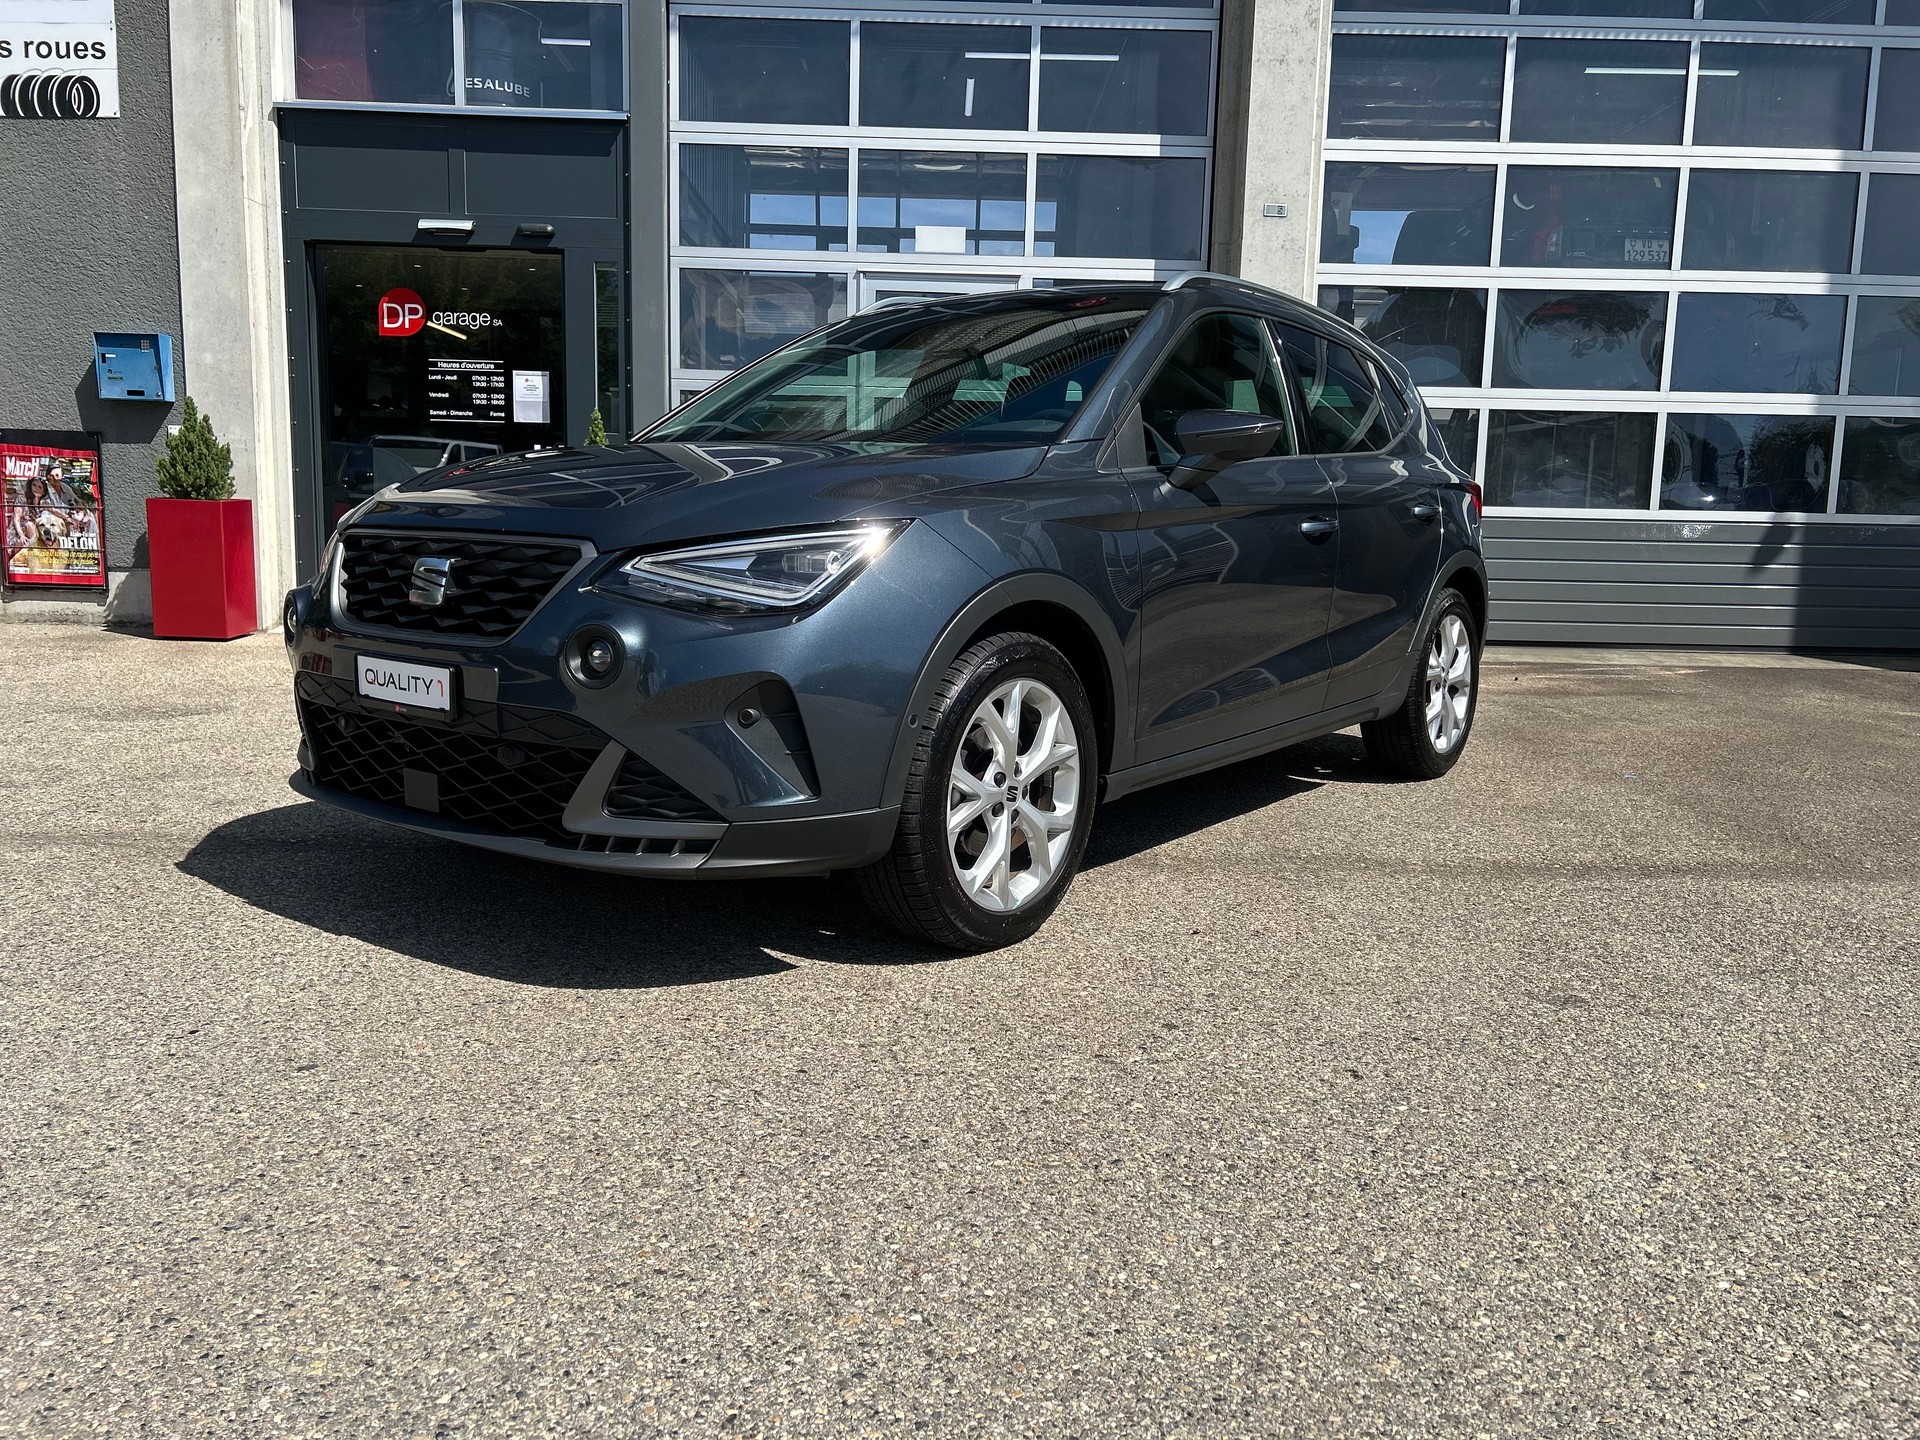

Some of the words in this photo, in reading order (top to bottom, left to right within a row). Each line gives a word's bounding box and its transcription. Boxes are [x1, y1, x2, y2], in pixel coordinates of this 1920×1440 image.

[24, 40, 107, 60] roues
[1641, 240, 1653, 249] VD
[383, 302, 424, 329] DP
[432, 311, 491, 330] garage
[492, 319, 503, 327] SA
[437, 361, 460, 369] Heures
[60, 536, 98, 550] DELON
[364, 668, 434, 695] QUALITY
[437, 679, 445, 698] 1
